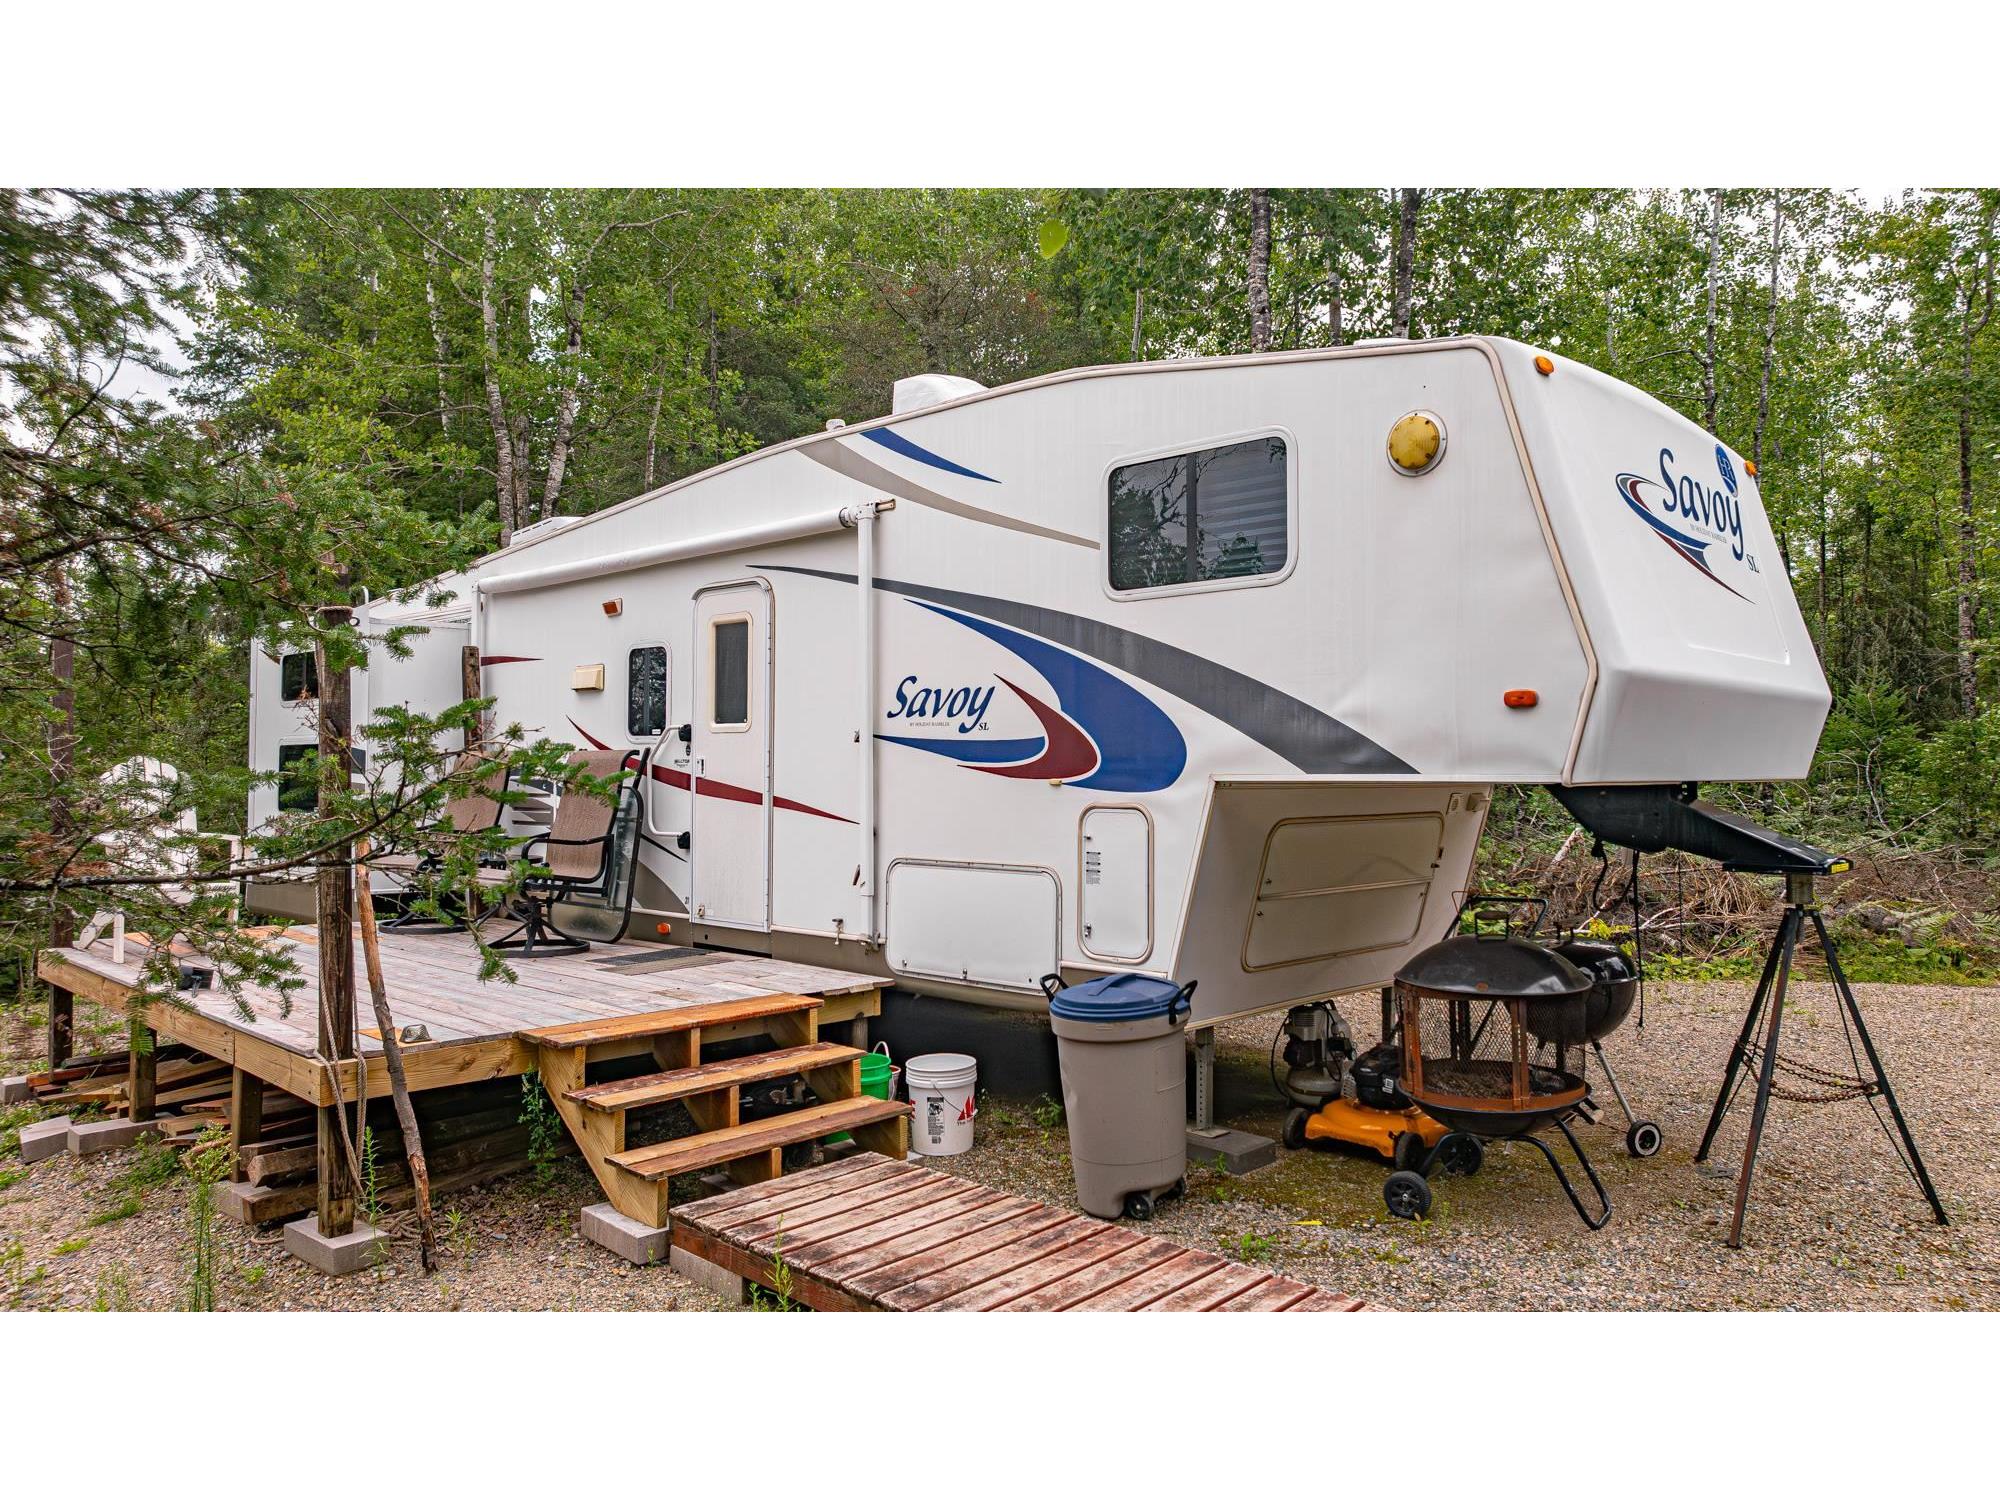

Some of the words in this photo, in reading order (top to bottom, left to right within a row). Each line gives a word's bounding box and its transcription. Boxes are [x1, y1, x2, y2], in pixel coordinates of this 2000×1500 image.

[1659, 447, 1744, 562] Savoy
[1746, 554, 1760, 574] SL
[887, 675, 995, 734] Savoy
[978, 722, 989, 731] SL
